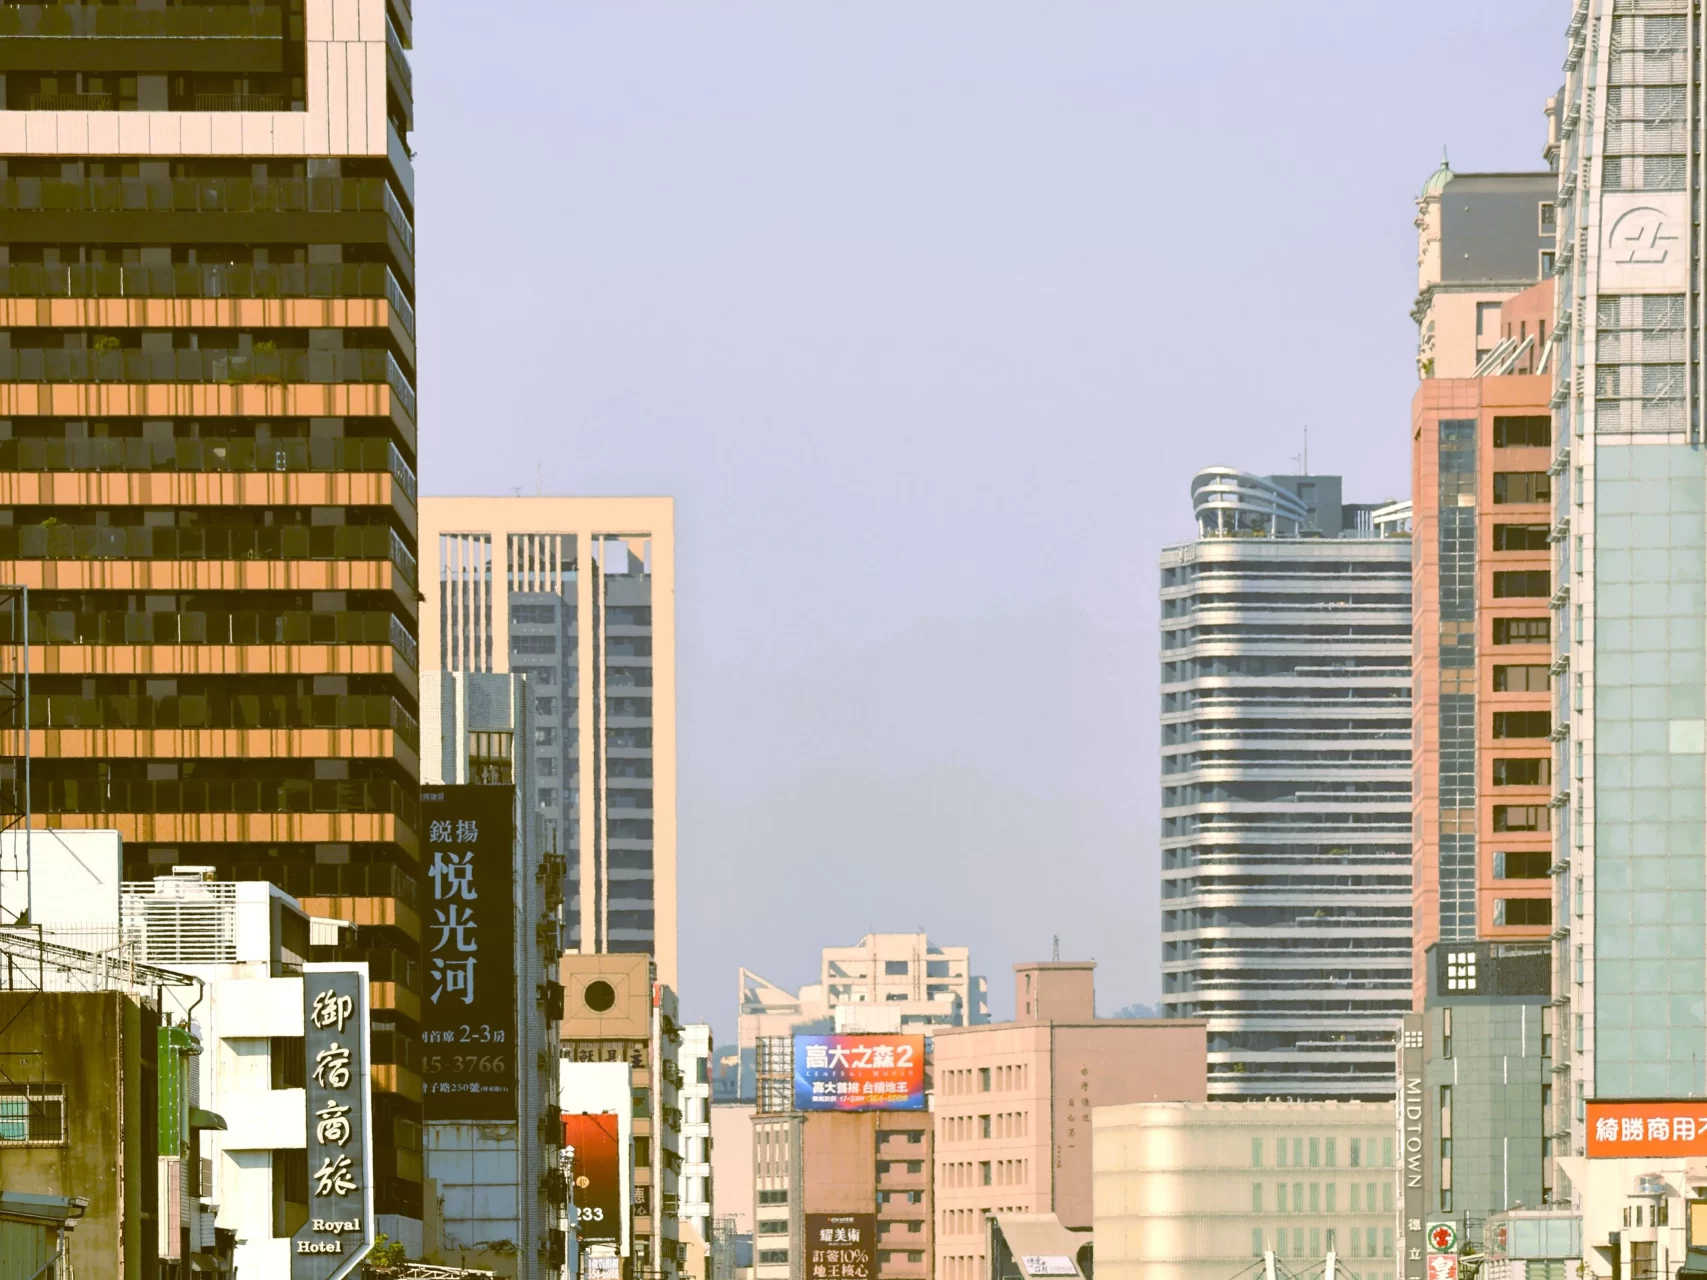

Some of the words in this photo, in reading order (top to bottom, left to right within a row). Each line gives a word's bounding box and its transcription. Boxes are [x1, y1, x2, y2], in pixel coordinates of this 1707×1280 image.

[805, 1045, 913, 1068] 高大之森2
[312, 989, 357, 1197] 御宿商旅
[1406, 1078, 1422, 1188] MIDTOWN
[312, 1219, 361, 1232] Royal
[297, 1240, 341, 1254] Hotel
